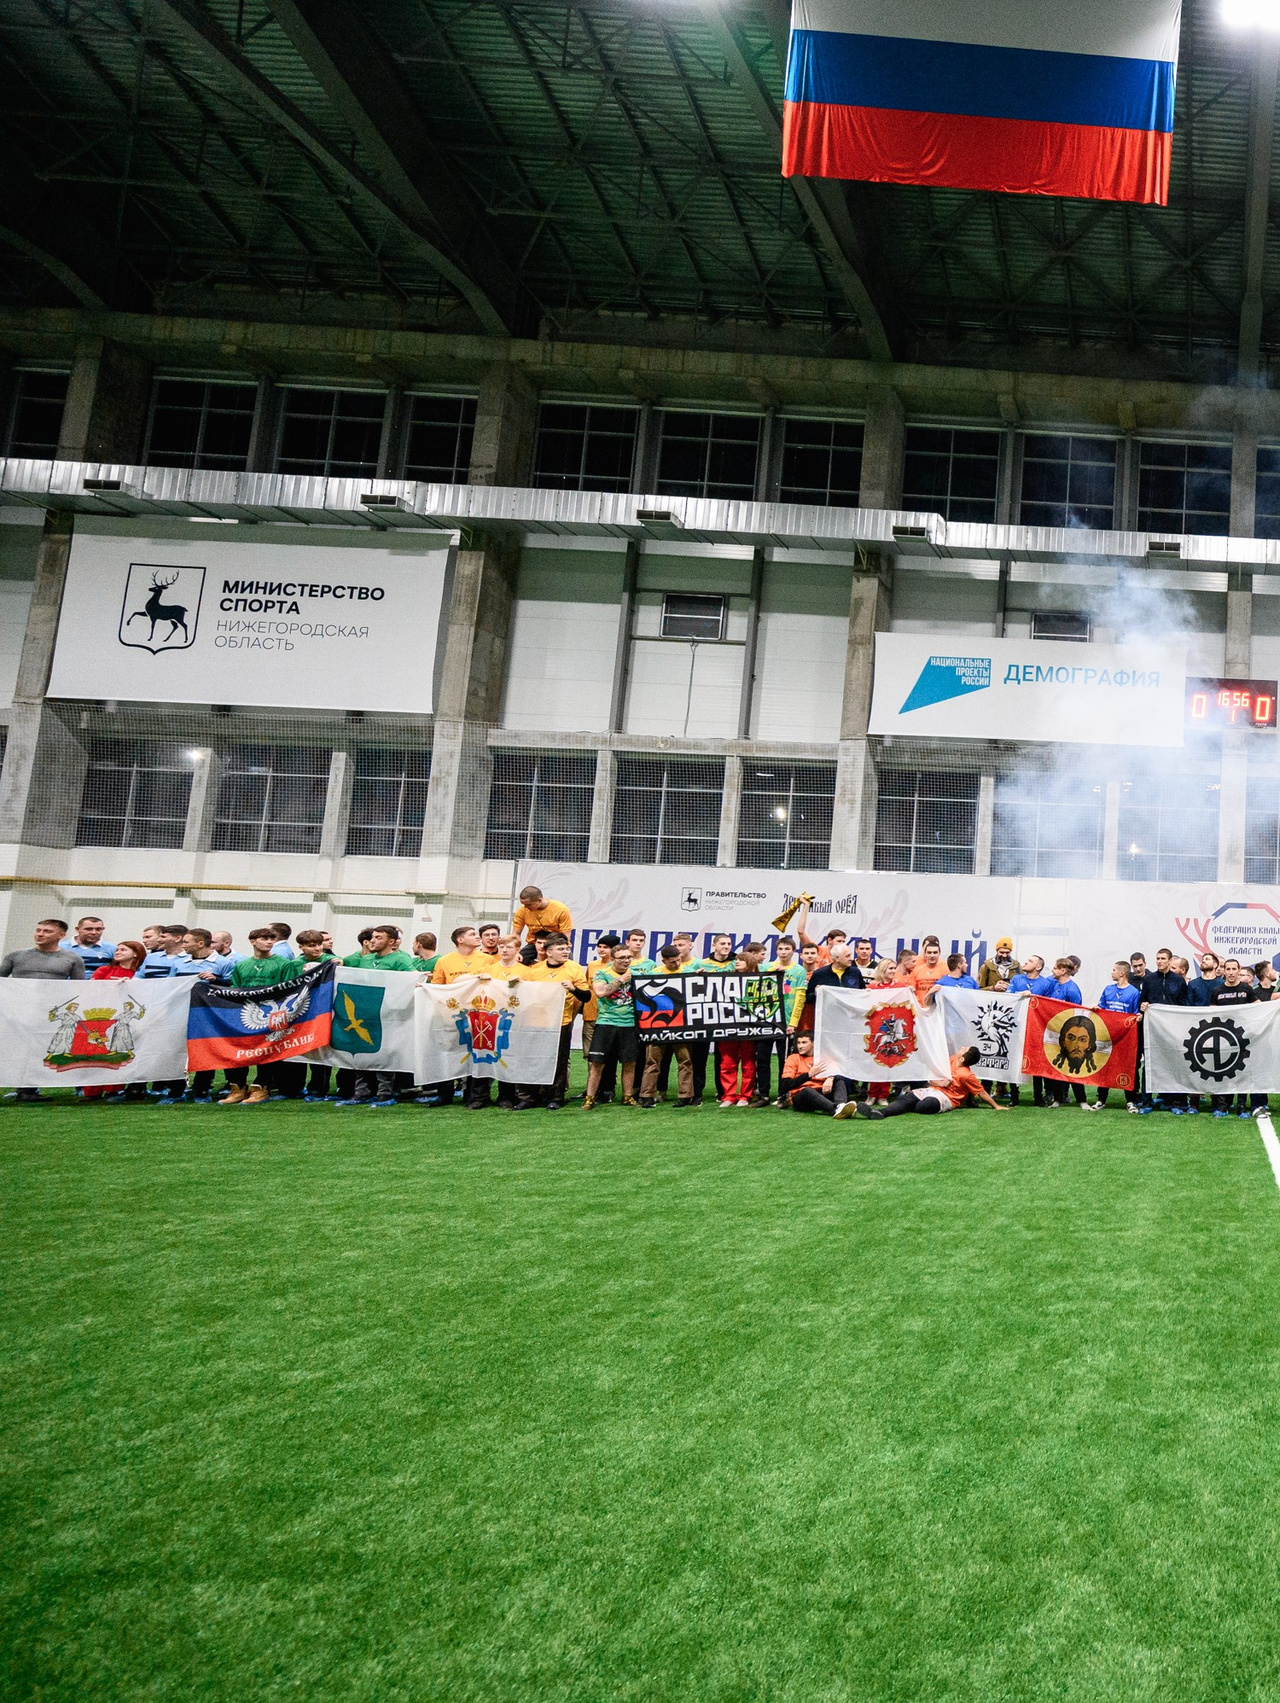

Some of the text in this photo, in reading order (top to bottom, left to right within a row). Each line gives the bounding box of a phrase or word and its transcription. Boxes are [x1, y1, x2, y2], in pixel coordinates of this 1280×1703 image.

[221, 580, 385, 601] МИНИСТЕРСТВО
[219, 598, 300, 615] СПОРТА
[216, 620, 369, 639] НИЖЕГОРОДСКАЯ
[213, 635, 294, 651] ОБЛАСТЬ
[930, 657, 990, 668] НАЦИОНАЛЬНЫЕ
[955, 667, 990, 677] ПРОЕКТЫ
[1003, 664, 1160, 688] ДЕМОГРАФИЯ
[961, 676, 990, 686] РОССИИ
[1192, 694, 1206, 718] 0
[1255, 697, 1271, 720] 0
[705, 891, 767, 899] ПРАВИТЕЛЬСТВО
[705, 899, 760, 907] НИЖЕГОРОДСКОЙ
[835, 894, 858, 914] ОРЁЛ
[1212, 925, 1280, 935] ФЕДЕРАЦИЯ КИЛЫ
[1214, 936, 1277, 945] НИЖЕГОРОДСКОЙ
[1228, 947, 1262, 955] ОБЛАСТИ
[712, 1027, 784, 1038] ДРУЖБА
[982, 1043, 992, 1051] 34
